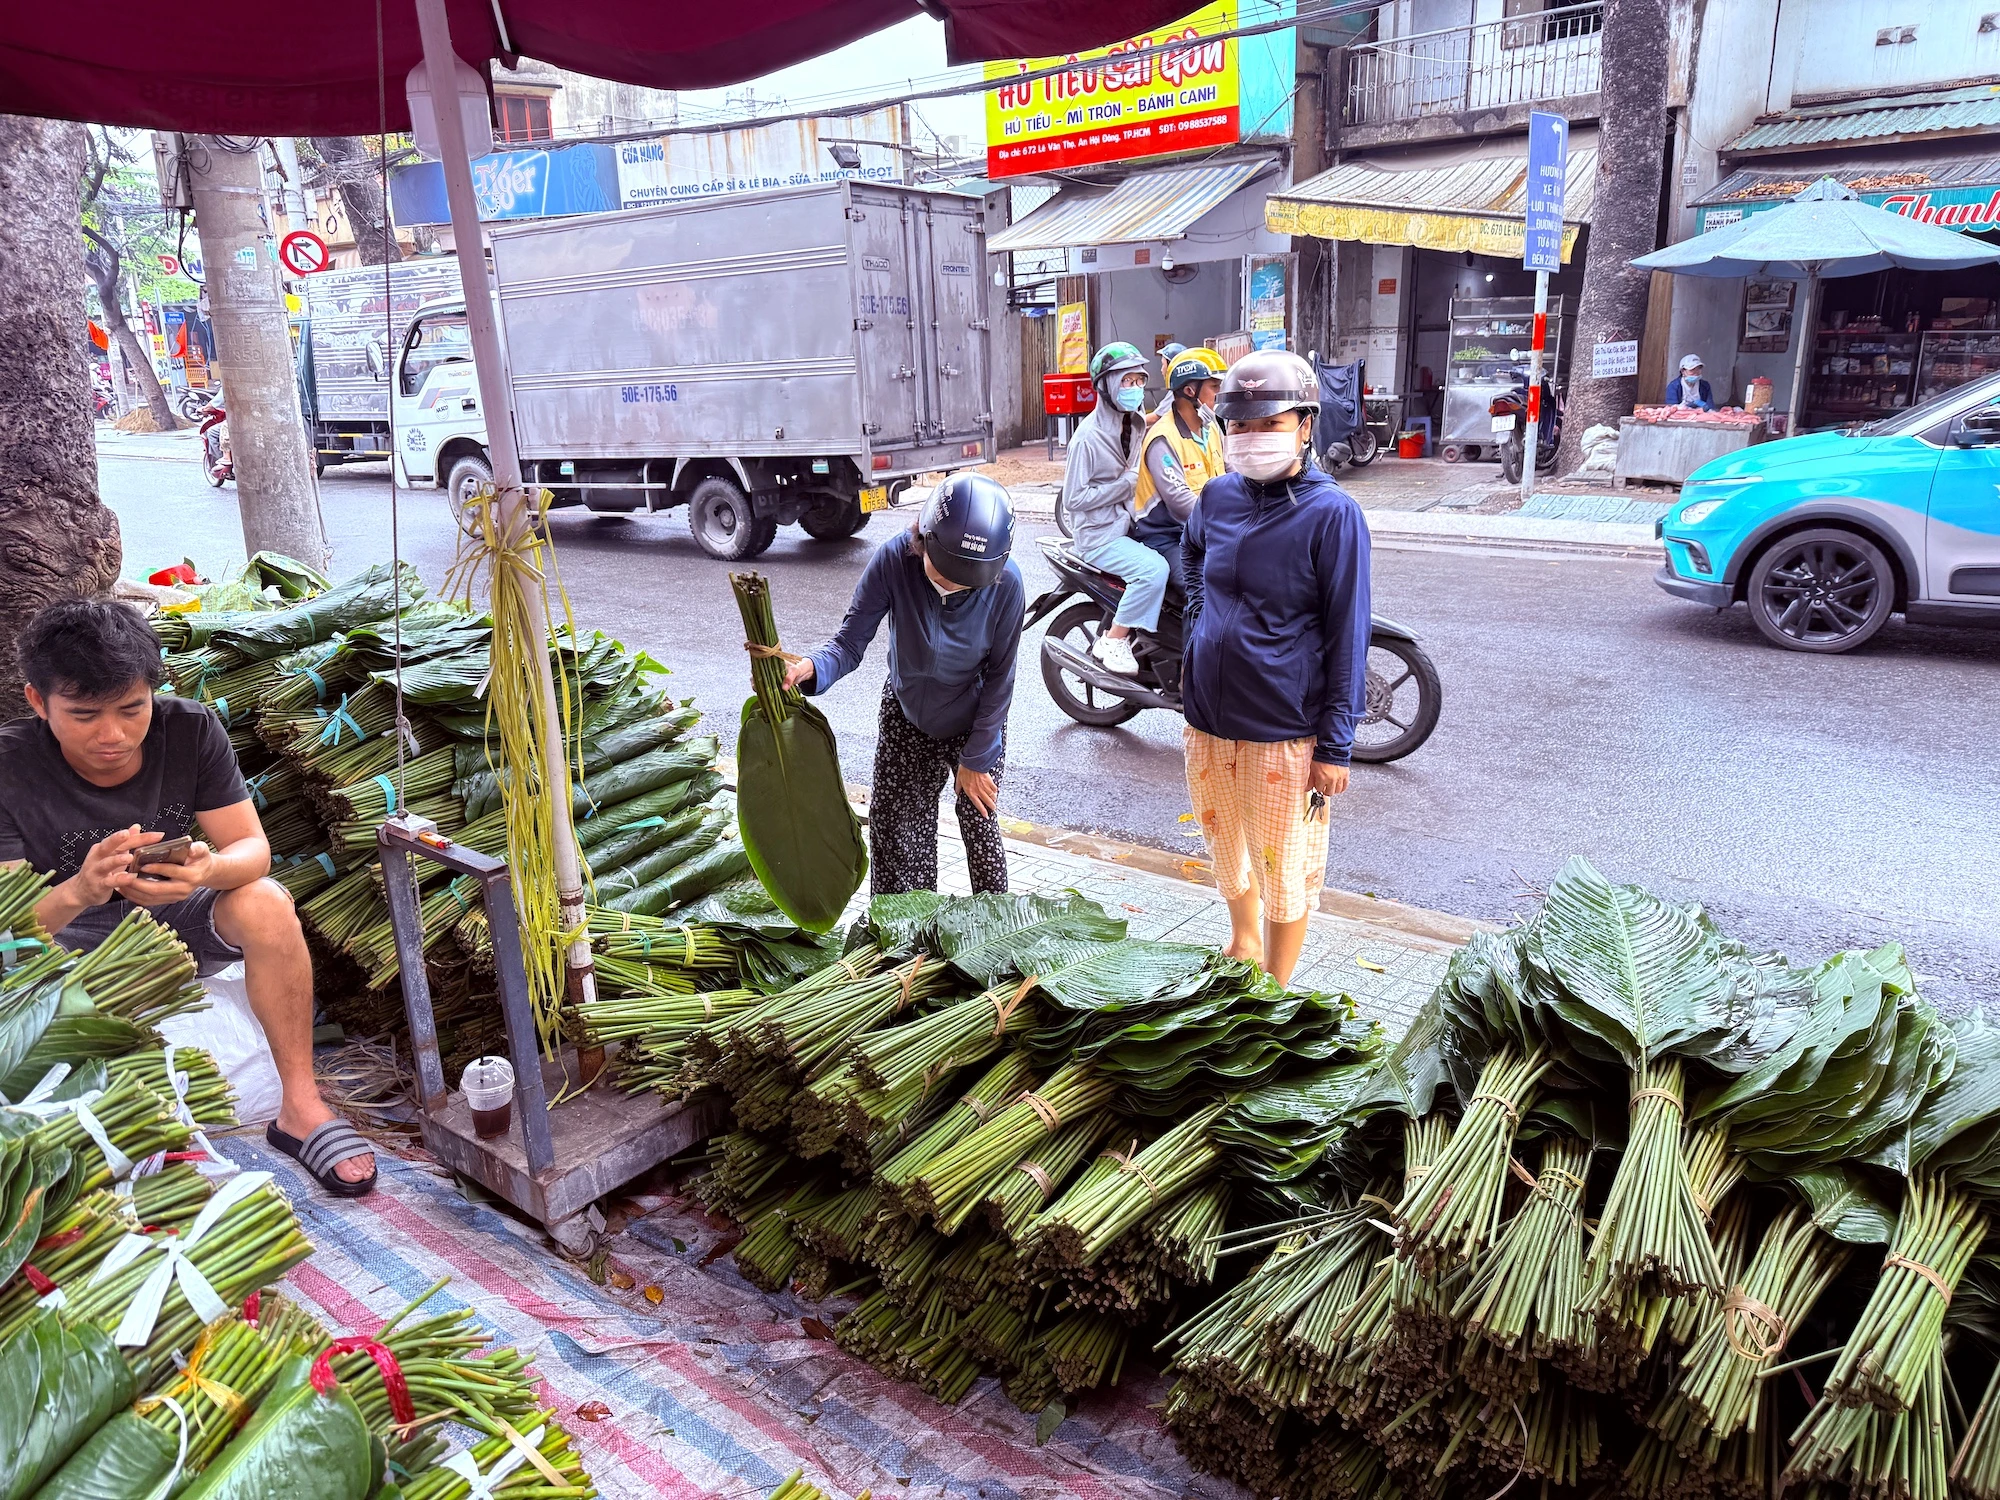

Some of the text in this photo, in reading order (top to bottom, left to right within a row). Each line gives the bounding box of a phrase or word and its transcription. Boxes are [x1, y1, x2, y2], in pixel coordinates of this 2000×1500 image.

[1005, 116, 1021, 135] HỦ
[1025, 111, 1051, 132] TIẾU
[1067, 106, 1083, 125] MÌ
[1088, 101, 1121, 121] TRỘN
[1138, 93, 1174, 113] BÁNH
[1180, 85, 1216, 105] CANH
[1022, 145, 1037, 156] 672
[1078, 138, 1088, 147] An
[1177, 114, 1228, 132] 0988537588
[474, 157, 537, 210] Tiger
[629, 185, 668, 200] CHUYÊN
[670, 183, 700, 196] CUNG
[702, 178, 725, 193] CẤP
[738, 180, 748, 190] &
[762, 177, 781, 188] BIA
[1542, 183, 1553, 196] XE
[865, 259, 888, 269] THACO
[942, 264, 970, 274] FRONTIER
[860, 294, 908, 316] 50E-175.56
[621, 384, 678, 403] 50E-175.56
[864, 496, 886, 512] 175.56
[867, 489, 880, 500] 50E
